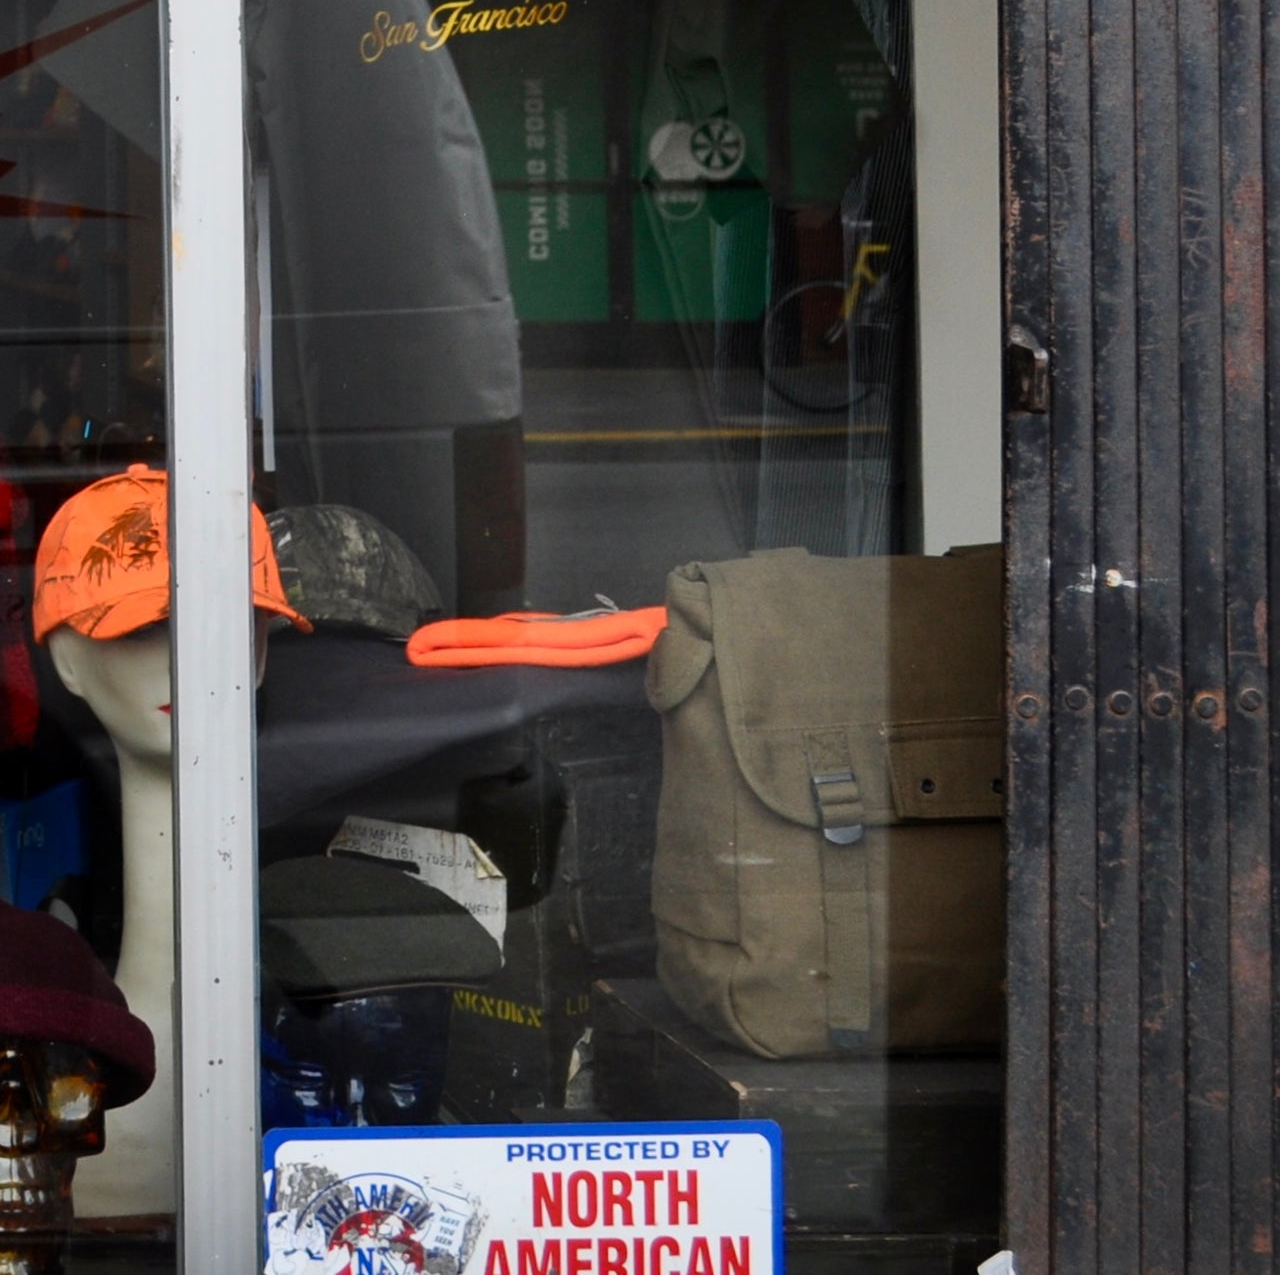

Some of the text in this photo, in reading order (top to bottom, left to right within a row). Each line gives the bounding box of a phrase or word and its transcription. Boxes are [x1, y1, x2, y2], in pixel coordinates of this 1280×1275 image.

[360, 8, 418, 64] San
[506, 1140, 730, 1163] PROTECTED BY
[531, 1169, 699, 1229] NORTH
[483, 1236, 752, 1275] AMERICAN
